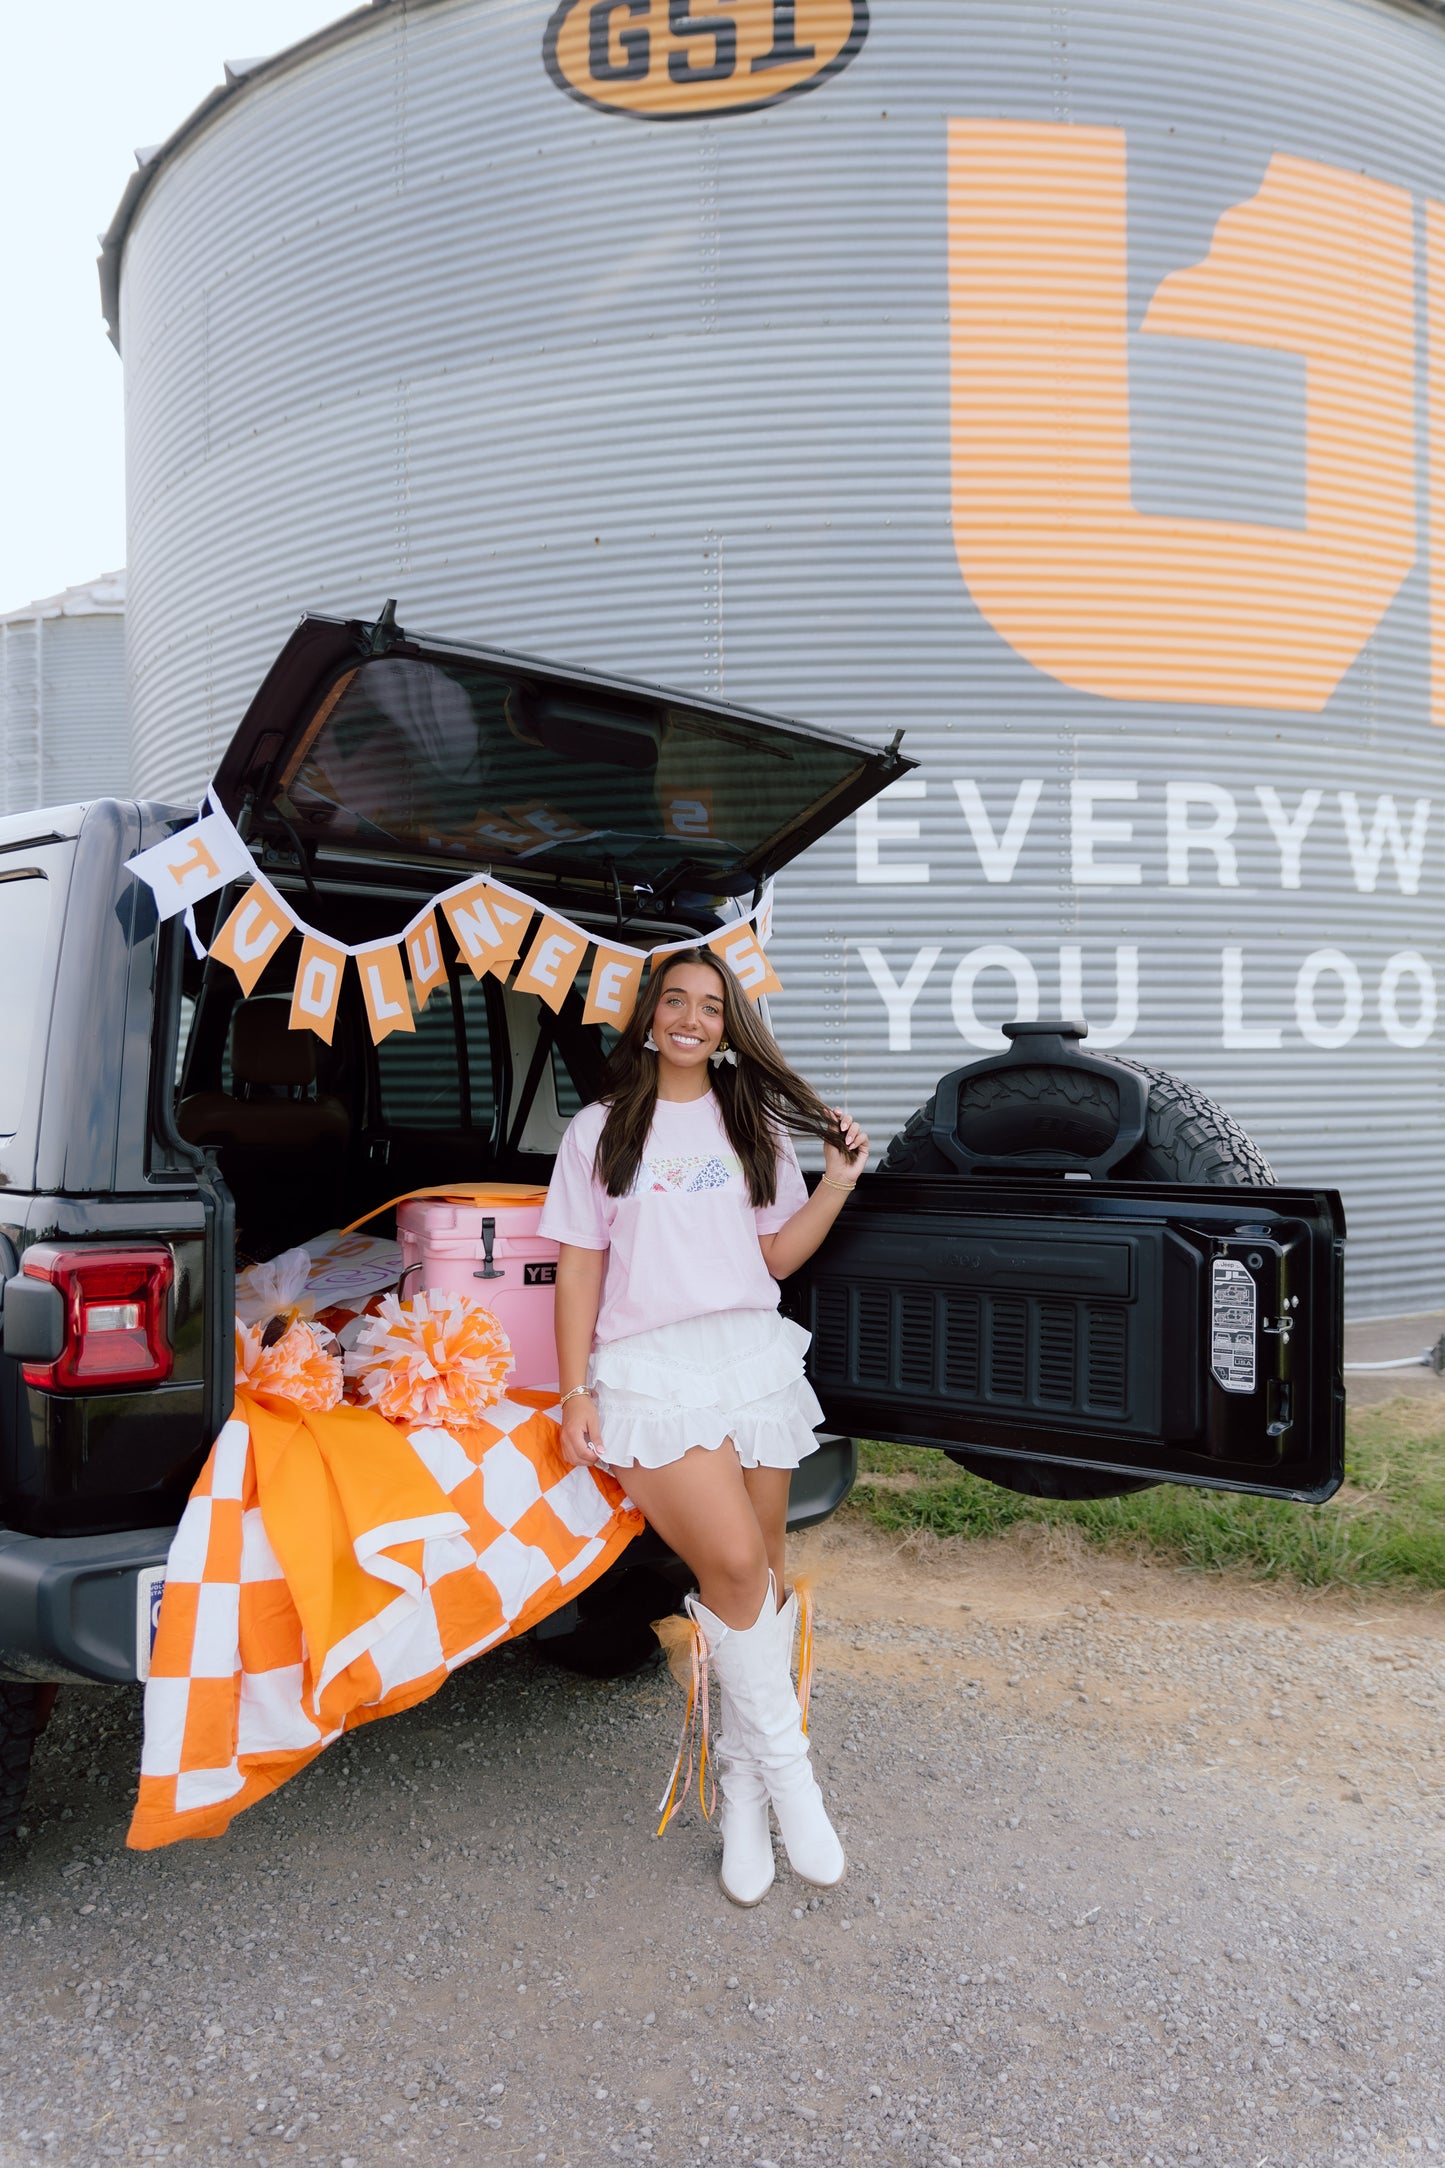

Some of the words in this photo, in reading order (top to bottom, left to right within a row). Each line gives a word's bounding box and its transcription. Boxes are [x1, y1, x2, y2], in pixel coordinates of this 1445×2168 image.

[588, 0, 816, 83] GSI
[855, 779, 1431, 895] EVERYW
[857, 945, 1140, 1052] YOU
[526, 1267, 557, 1282] YE
